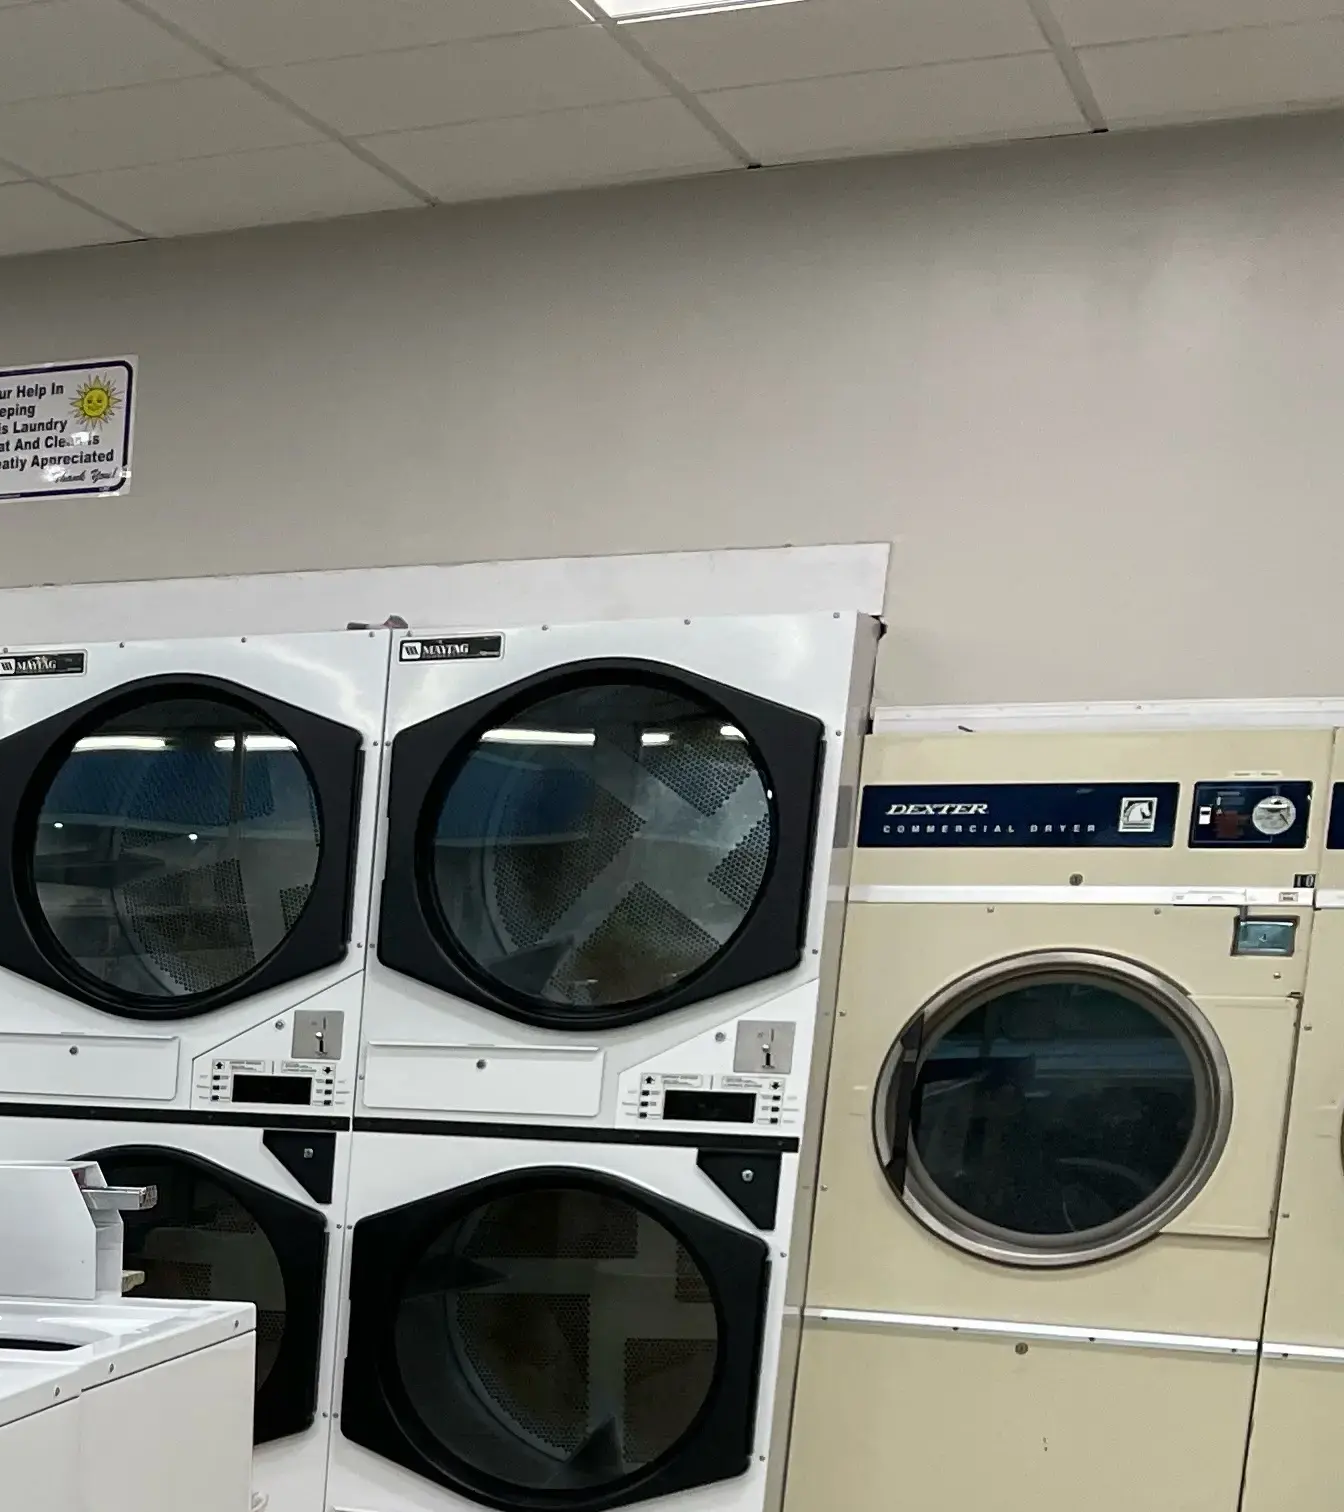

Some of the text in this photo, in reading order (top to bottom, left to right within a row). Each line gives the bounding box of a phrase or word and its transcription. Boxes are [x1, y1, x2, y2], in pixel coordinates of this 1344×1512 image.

[17, 384, 47, 399] Help
[51, 382, 64, 395] In
[13, 418, 68, 433] Laundry
[14, 438, 40, 451] And
[31, 449, 114, 469] Appreciated
[423, 644, 469, 655] MAYTAG
[16, 660, 57, 671] MAYTAG
[885, 803, 989, 815] DEXTER
[882, 824, 1096, 833] COMMERCIAL DRYER
